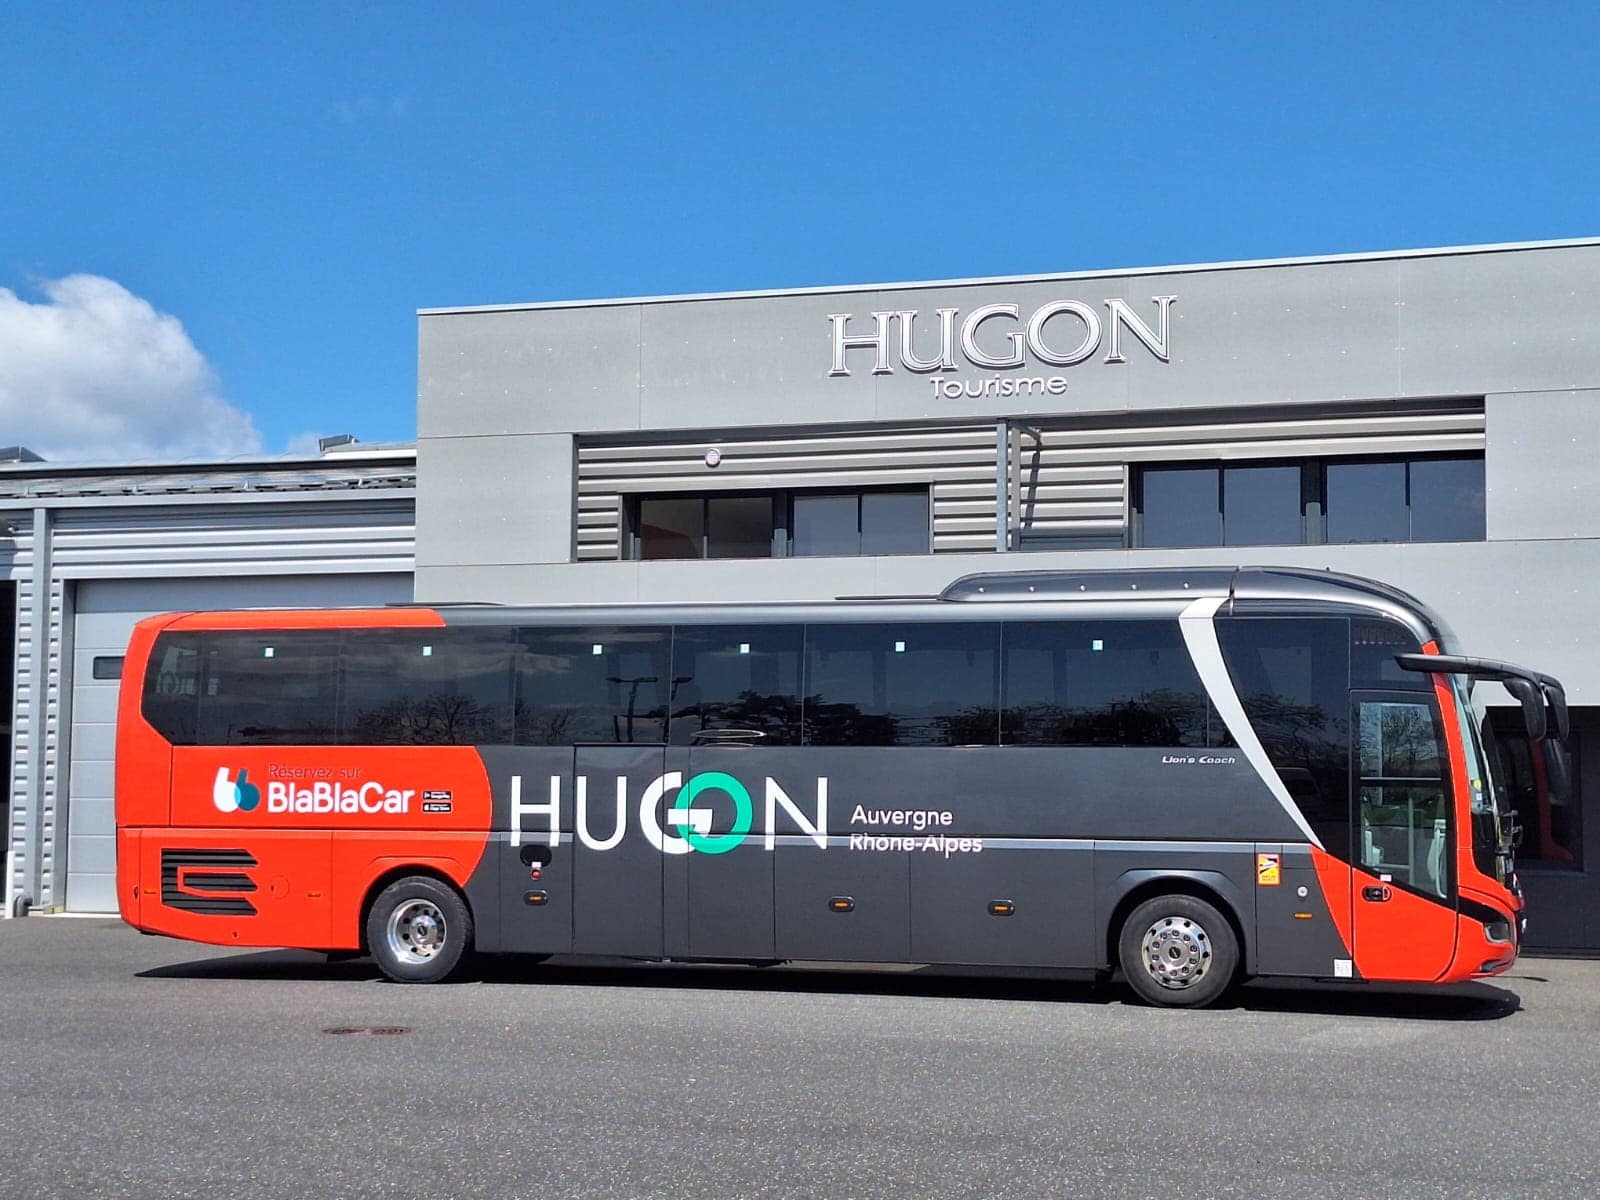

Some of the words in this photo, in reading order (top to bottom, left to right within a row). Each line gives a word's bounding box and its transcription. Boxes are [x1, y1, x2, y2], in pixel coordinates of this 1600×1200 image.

[828, 295, 1178, 376] HUGON
[930, 374, 1067, 399] Tourisme
[1162, 755, 1195, 764] Lion's
[1199, 755, 1236, 764] Coach
[339, 768, 362, 778] sur
[267, 781, 415, 814] BlaBlaCar
[510, 771, 828, 855] HUGON
[850, 804, 953, 830] Auvergne
[849, 833, 983, 859] Rhône-Alpes
